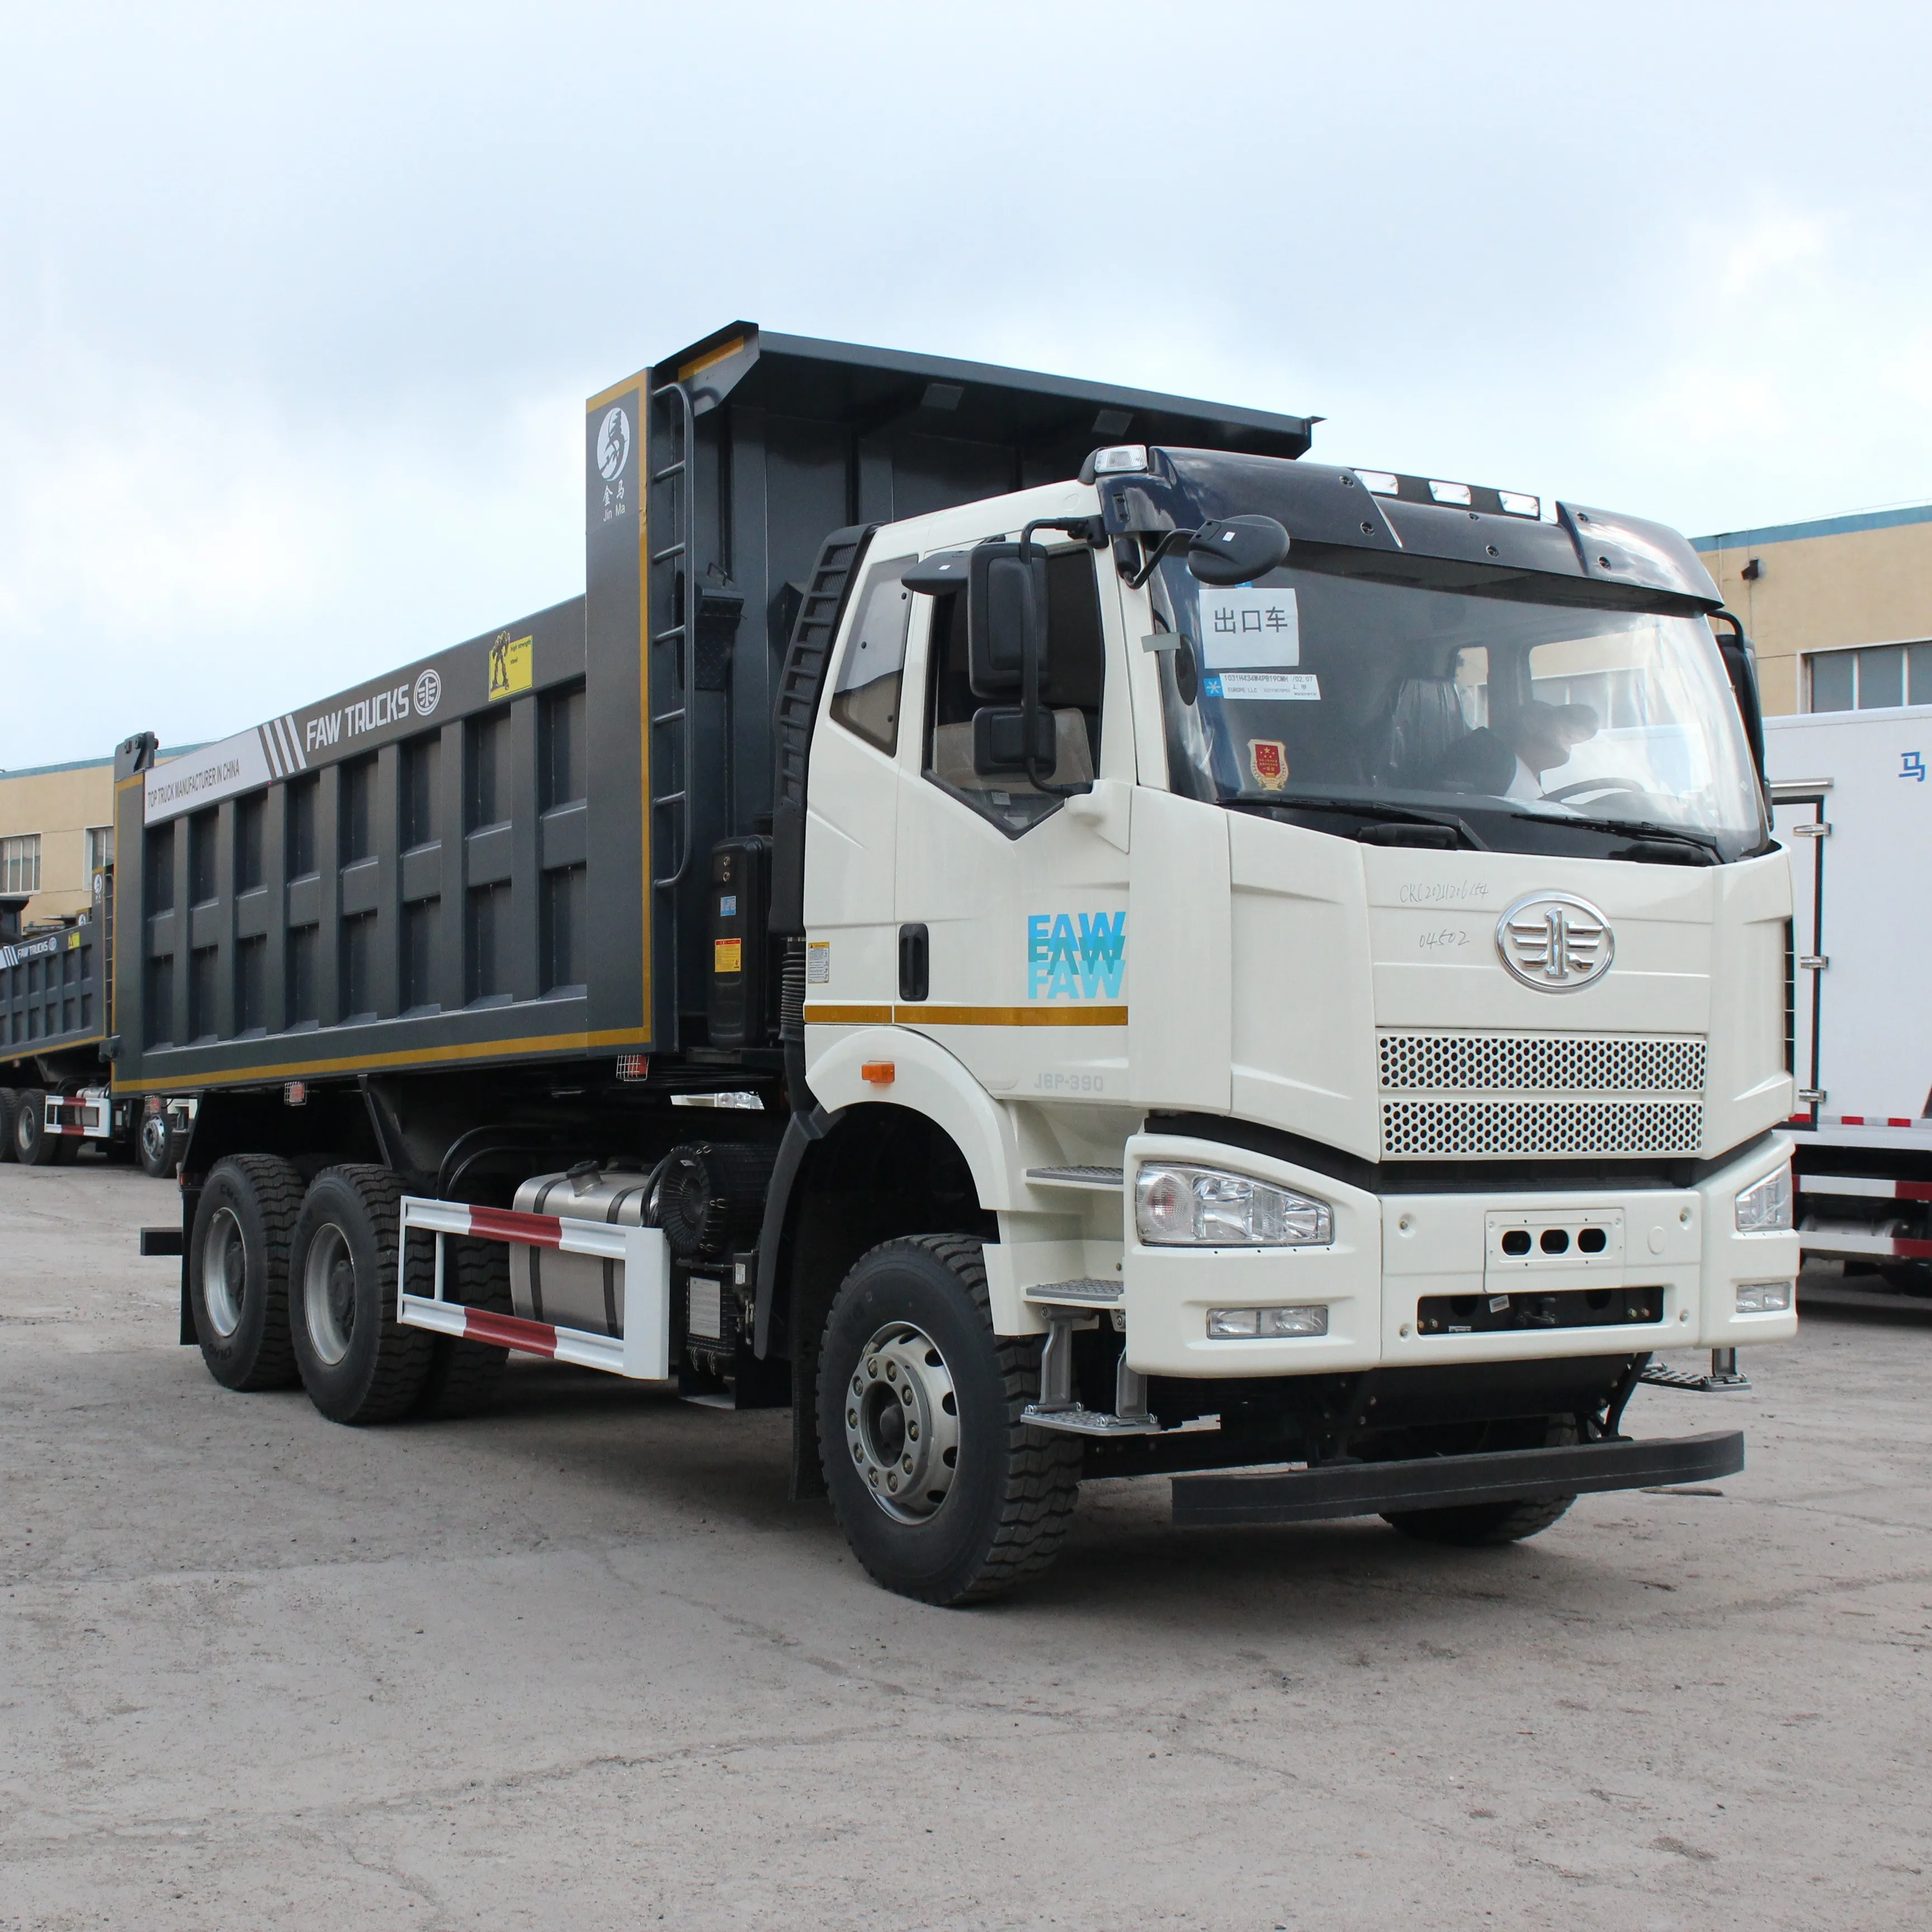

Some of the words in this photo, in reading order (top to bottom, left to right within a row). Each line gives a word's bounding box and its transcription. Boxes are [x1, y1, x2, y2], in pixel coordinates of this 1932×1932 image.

[603, 479, 625, 506] 金马
[603, 509, 613, 522] Jin
[615, 503, 626, 517] Ma
[1214, 606, 1288, 634] 出口车
[307, 710, 342, 752] FAW
[345, 684, 410, 737] TRUCKS
[1898, 751, 1926, 783] 马
[148, 789, 157, 808] TOP
[158, 783, 174, 805] TRUCK
[175, 767, 216, 798] MANUFACTURER
[217, 764, 222, 783] IN
[223, 758, 240, 781] CHINA
[1419, 929, 1470, 950] 04502
[1027, 959, 1126, 1000] FAW
